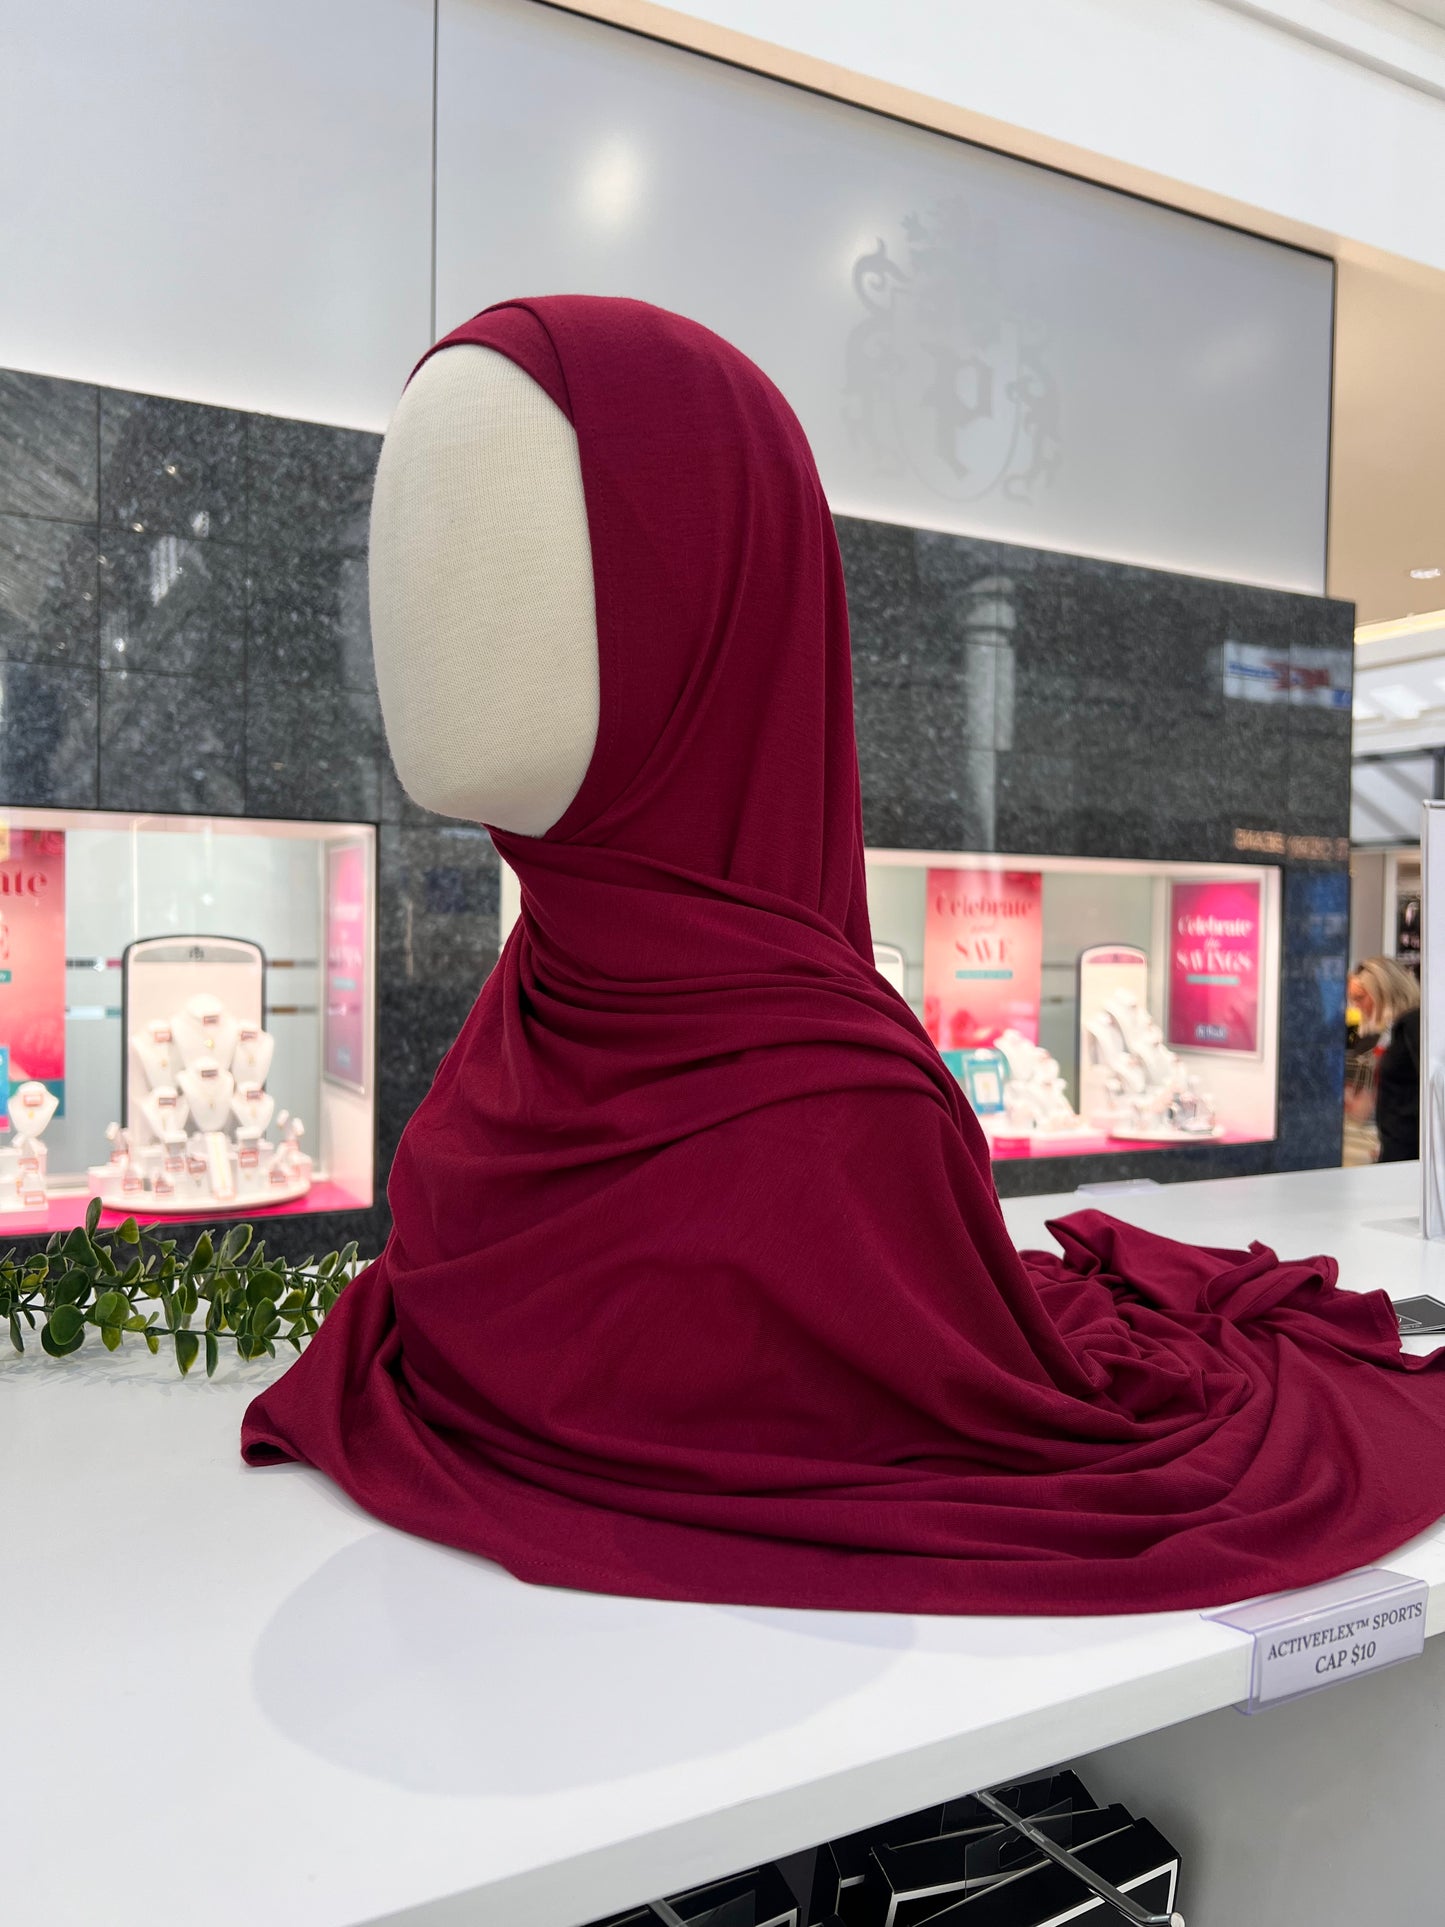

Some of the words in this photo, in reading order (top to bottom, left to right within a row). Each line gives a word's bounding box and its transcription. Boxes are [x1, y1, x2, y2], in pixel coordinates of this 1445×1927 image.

[1372, 1602, 1423, 1630] SPORTS
[1315, 1650, 1347, 1674] CAP
[1351, 1640, 1377, 1665] $10
